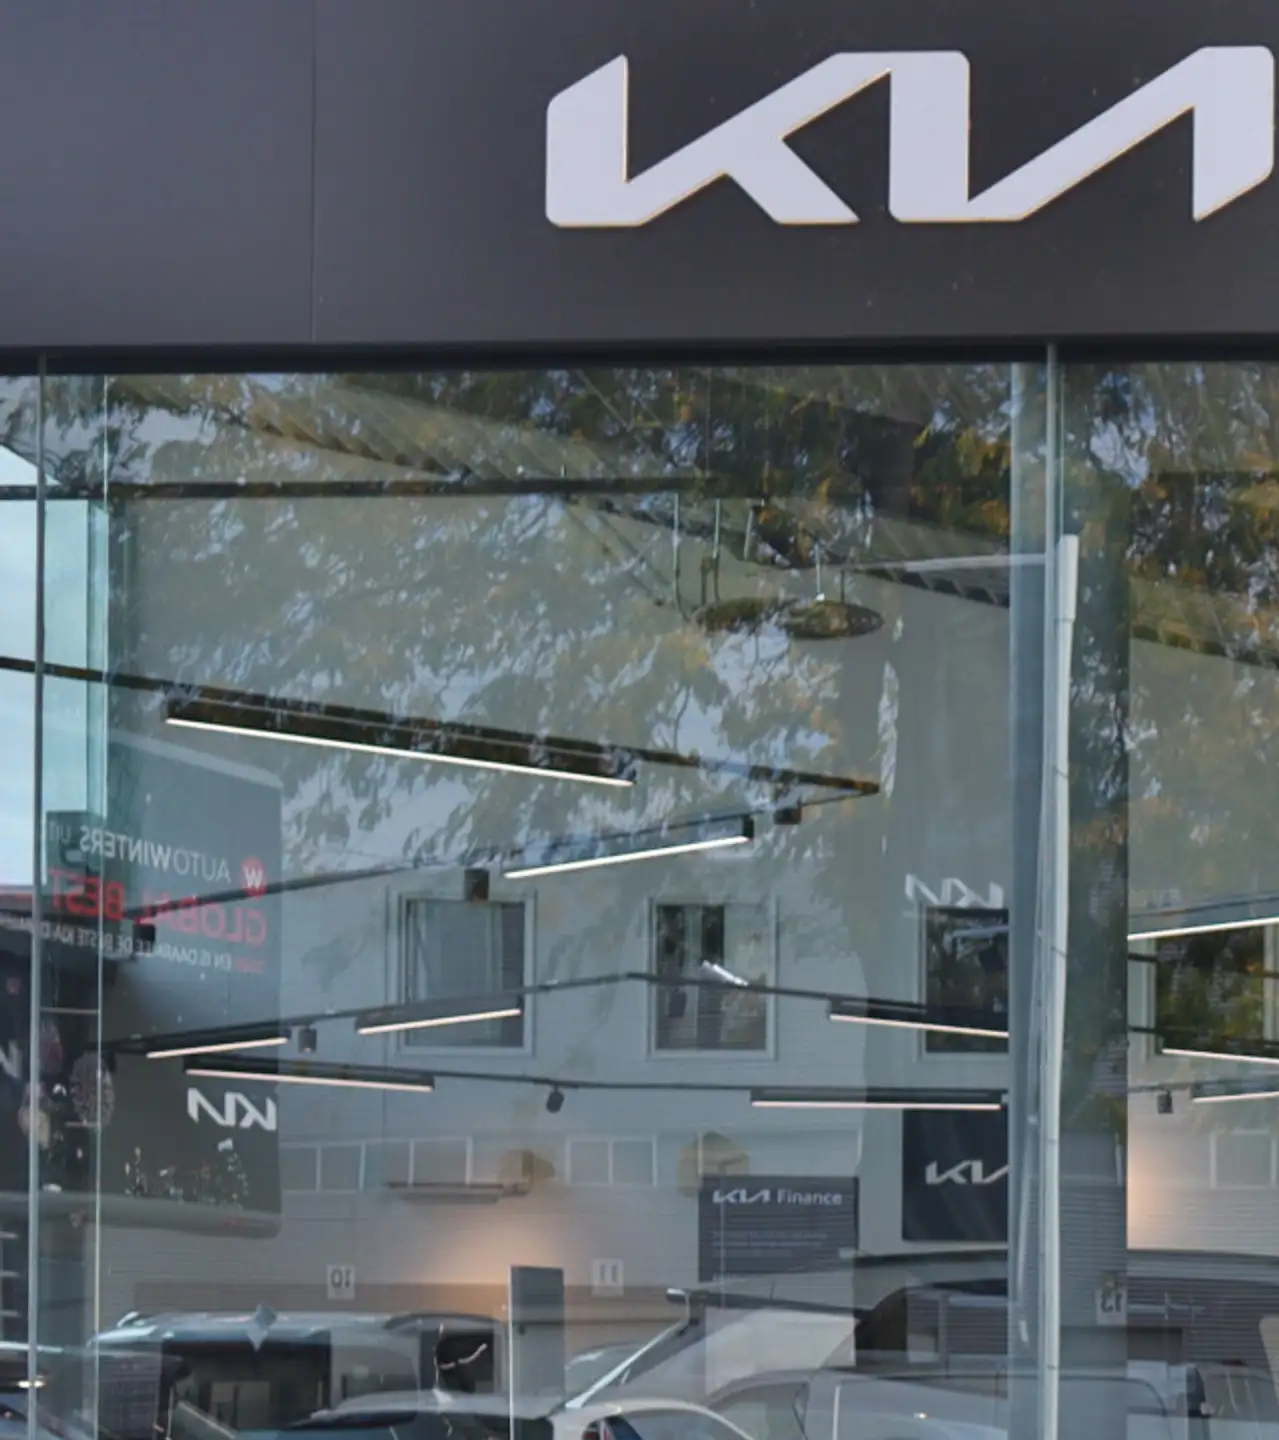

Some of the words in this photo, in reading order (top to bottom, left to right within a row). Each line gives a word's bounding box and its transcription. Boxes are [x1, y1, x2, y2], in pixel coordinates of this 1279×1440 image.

[546, 46, 1275, 228] KIA
[712, 1188, 771, 1205] KIA
[778, 1188, 843, 1205] Finance
